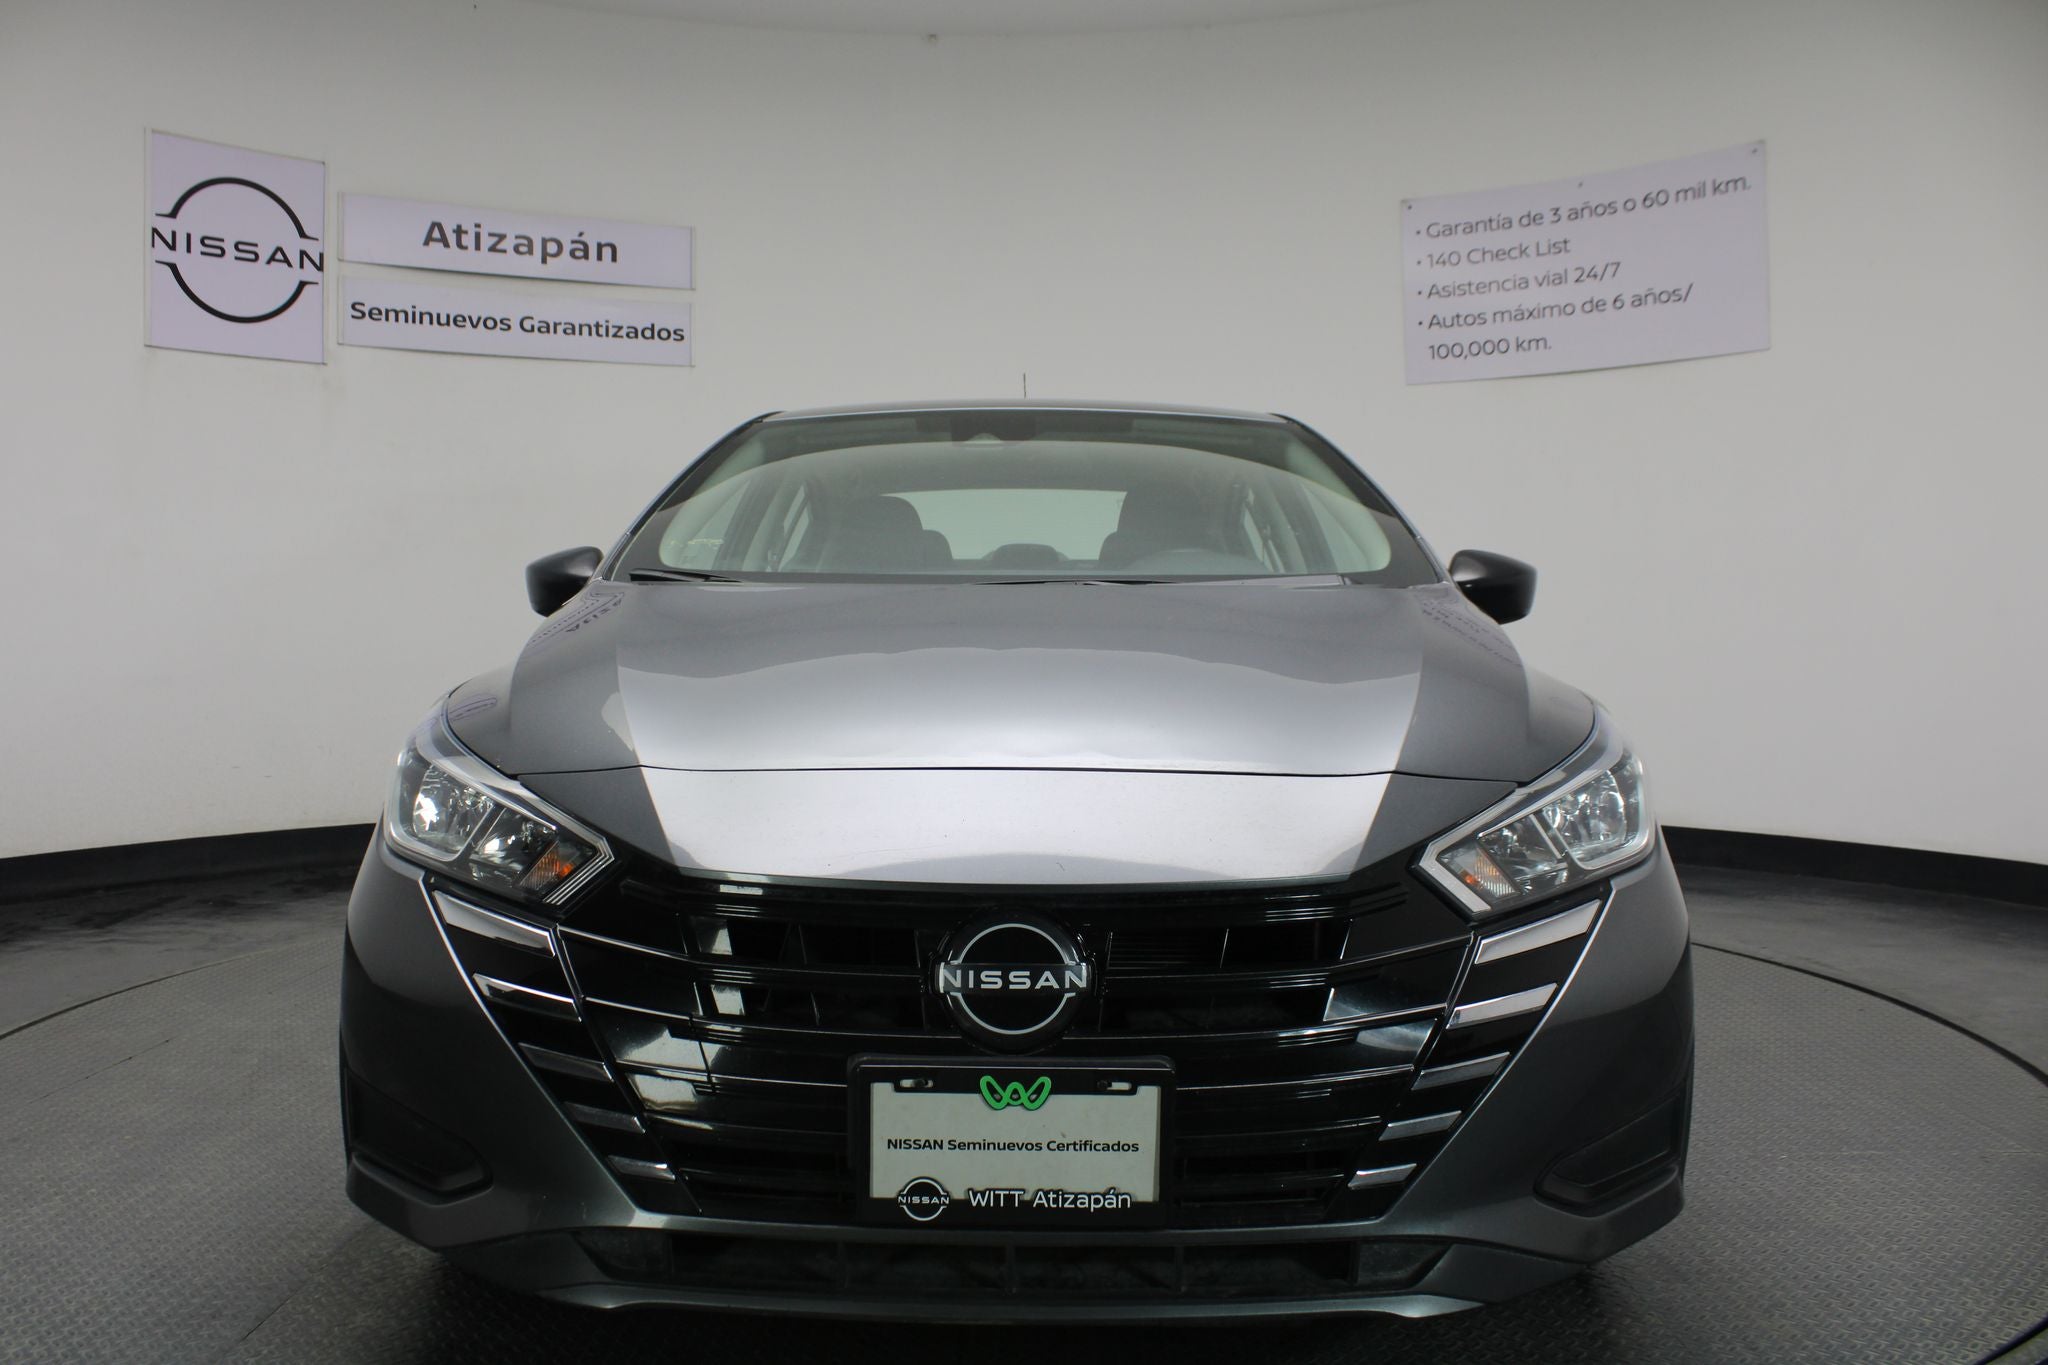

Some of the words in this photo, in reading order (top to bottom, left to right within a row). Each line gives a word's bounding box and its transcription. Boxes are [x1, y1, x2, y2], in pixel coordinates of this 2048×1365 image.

[1426, 213, 1513, 239] Garantía
[1519, 208, 1544, 228] de
[1550, 207, 1562, 224] 3
[1567, 200, 1618, 222] años
[1623, 197, 1637, 212] o
[1642, 188, 1670, 209] 60
[1674, 180, 1707, 202] mil
[1712, 173, 1752, 196] km.
[151, 226, 325, 273] NISSAN
[422, 220, 618, 264] Atizapán
[1427, 251, 1461, 269] 140
[1466, 242, 1530, 265] Check
[1536, 236, 1571, 257] List
[1427, 273, 1530, 299] Asistencia
[1534, 267, 1568, 287] vial
[1574, 261, 1622, 285] 24/7
[350, 301, 512, 333] Seminuevos
[519, 315, 686, 343] Garantizados
[1428, 310, 1487, 330] Autos
[1492, 300, 1576, 324] máximo
[1581, 295, 1607, 314] de
[1612, 294, 1625, 311] 6
[1630, 282, 1694, 309] años/
[1428, 338, 1510, 361] 100,000
[1515, 335, 1552, 353] km.
[940, 969, 1087, 991] NISSAN
[887, 1138, 944, 1150] NISSAN
[947, 1138, 1043, 1152] Seminuevos
[1046, 1139, 1139, 1153] Certificados
[898, 1194, 949, 1205] NISSAN
[968, 1189, 1024, 1208] WITT
[1033, 1188, 1131, 1212] Atizapán
